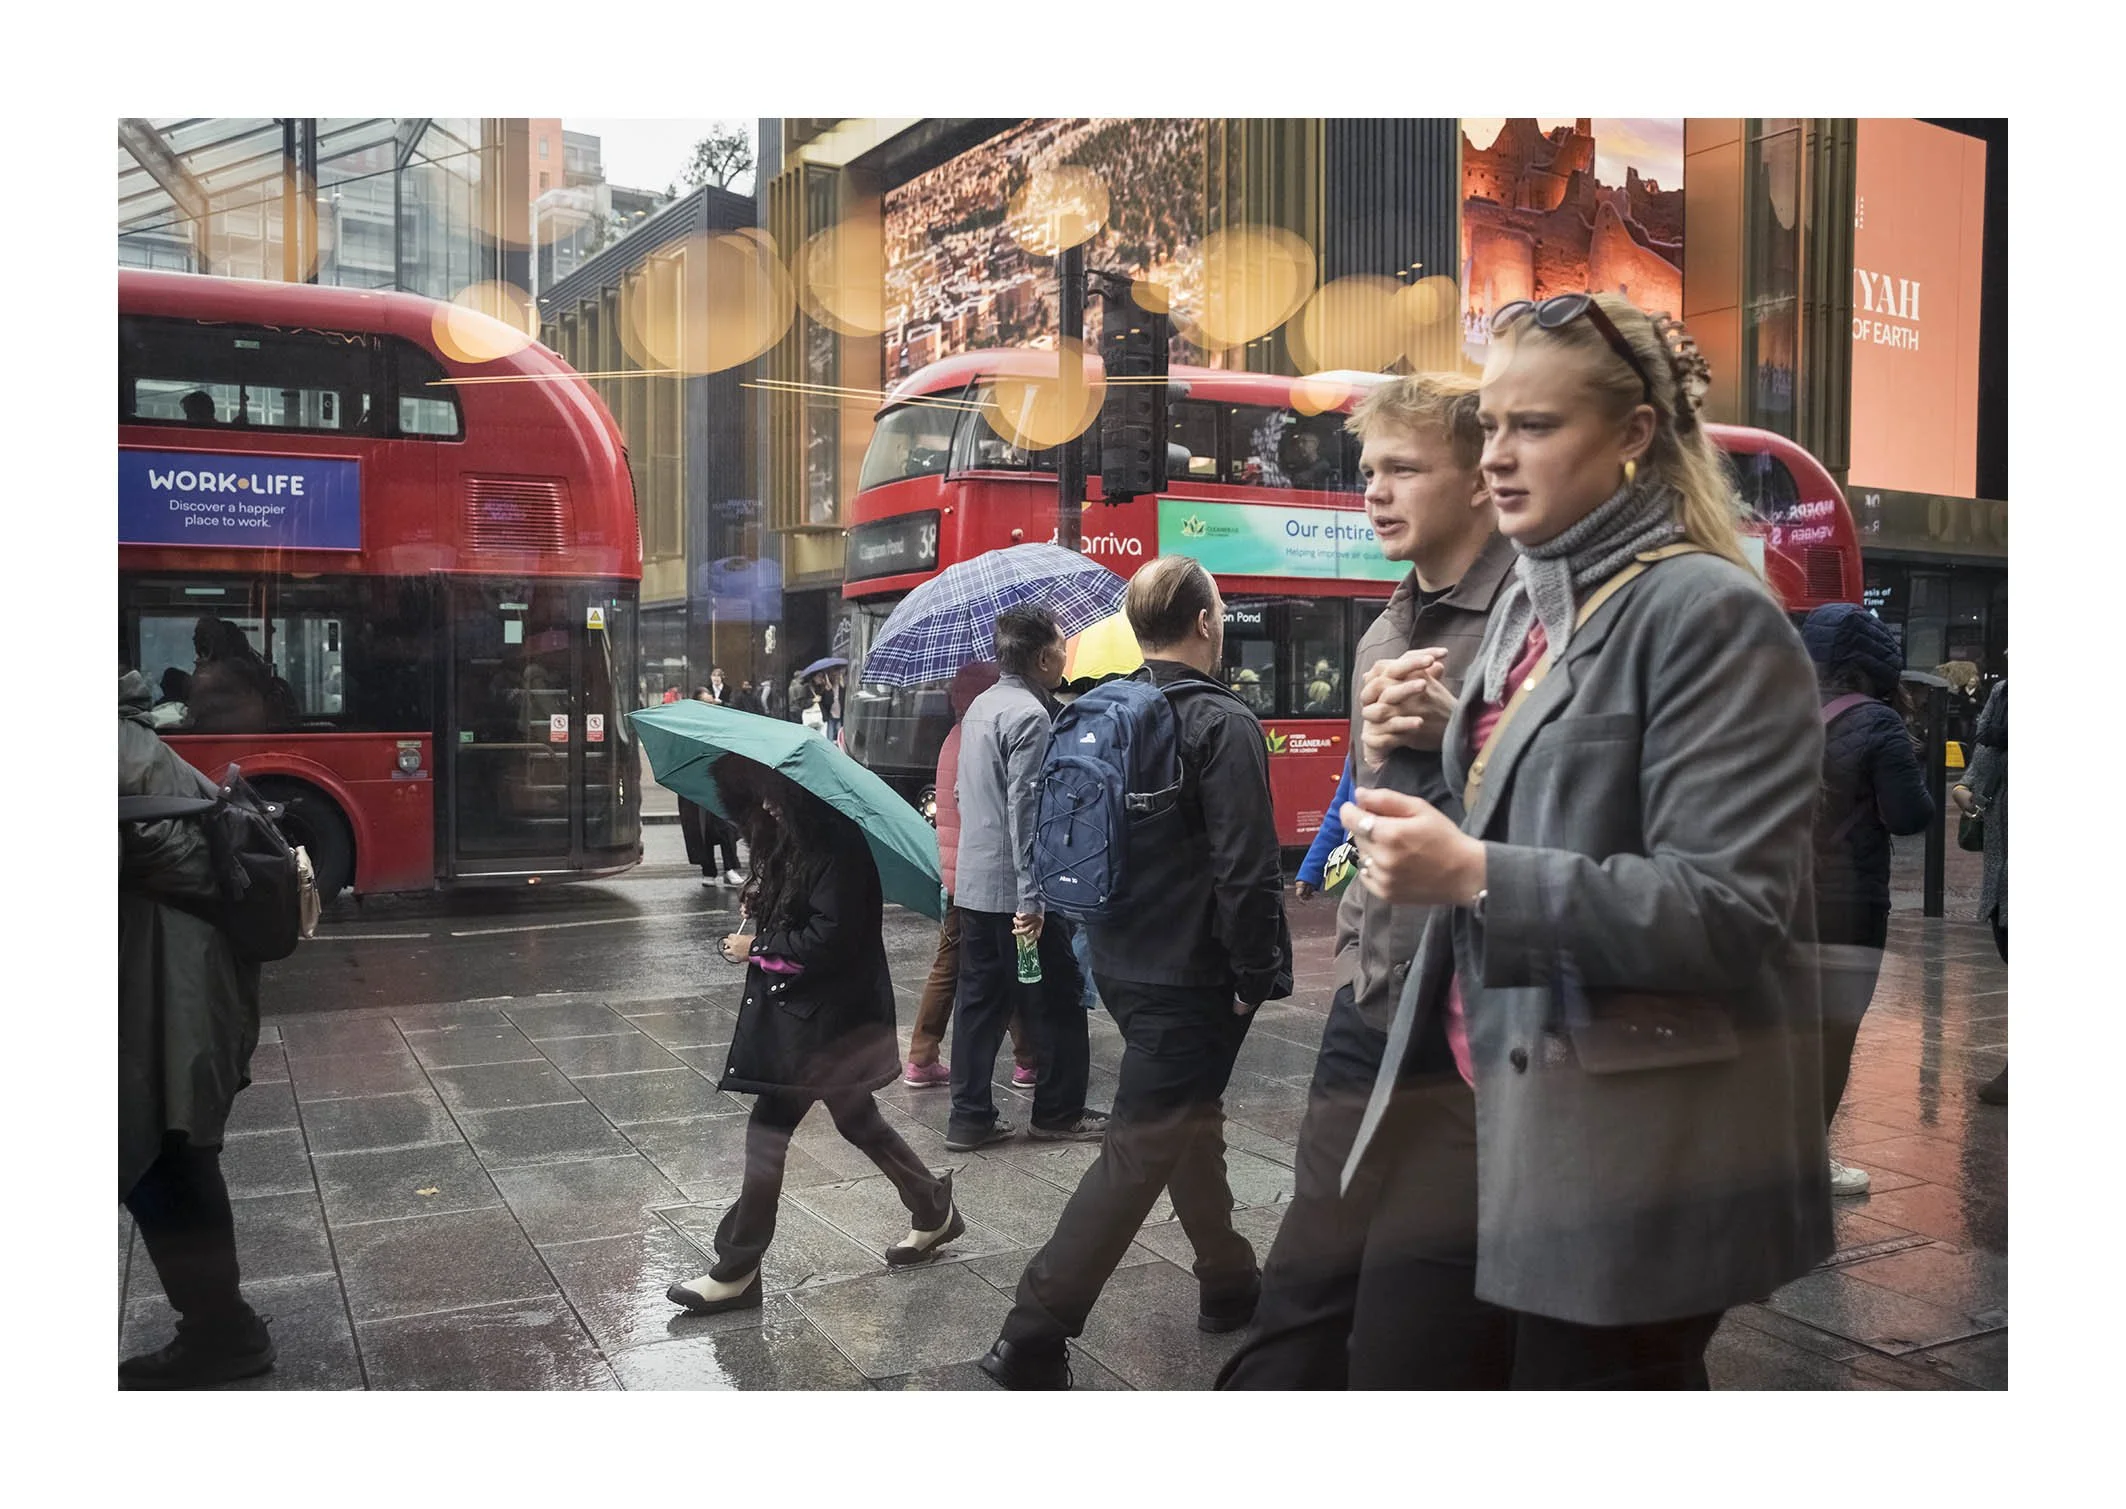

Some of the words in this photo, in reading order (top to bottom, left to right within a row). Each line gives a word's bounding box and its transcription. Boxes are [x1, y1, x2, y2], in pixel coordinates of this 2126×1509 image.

[1852, 317, 1872, 341] OF
[1873, 322, 1919, 351] EARTH
[169, 500, 225, 512] Discover
[228, 505, 236, 513] a
[238, 502, 286, 516] happier
[185, 515, 220, 527] place
[222, 516, 235, 527] to
[238, 517, 272, 528] work.
[1286, 519, 1318, 538] Our
[1324, 524, 1375, 541] entire
[918, 523, 936, 559] 38
[1081, 532, 1142, 555] arriva
[1286, 547, 1316, 558] Helping
[1864, 588, 1880, 597] asis
[1236, 611, 1261, 623] Pond
